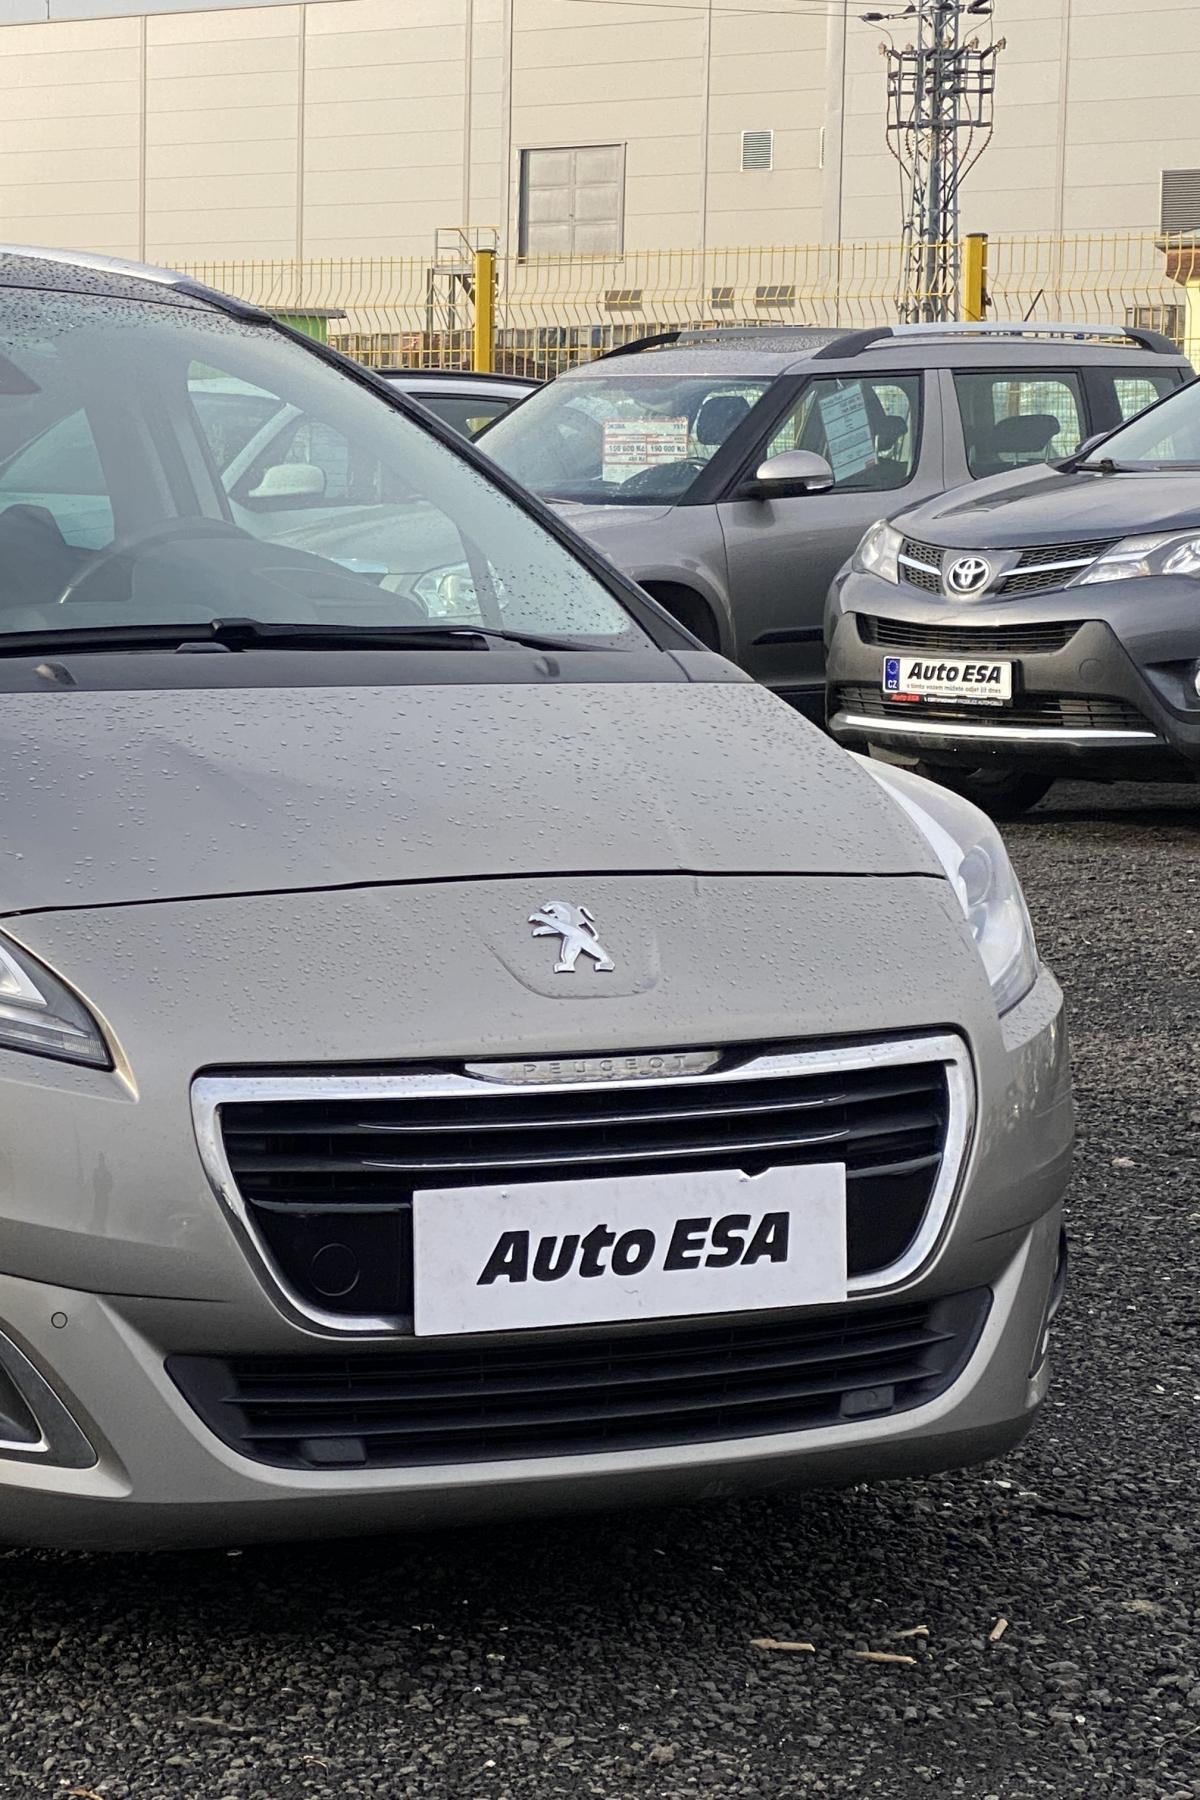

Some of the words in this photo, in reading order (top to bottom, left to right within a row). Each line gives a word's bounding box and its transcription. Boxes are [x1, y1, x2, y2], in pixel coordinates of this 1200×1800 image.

[908, 662, 959, 682] Auto
[962, 664, 1001, 684] ESA
[887, 679, 898, 689] CZ
[523, 1055, 687, 1075] PEUGEOT
[476, 1223, 656, 1286] Auto
[663, 1211, 791, 1271] ESA
